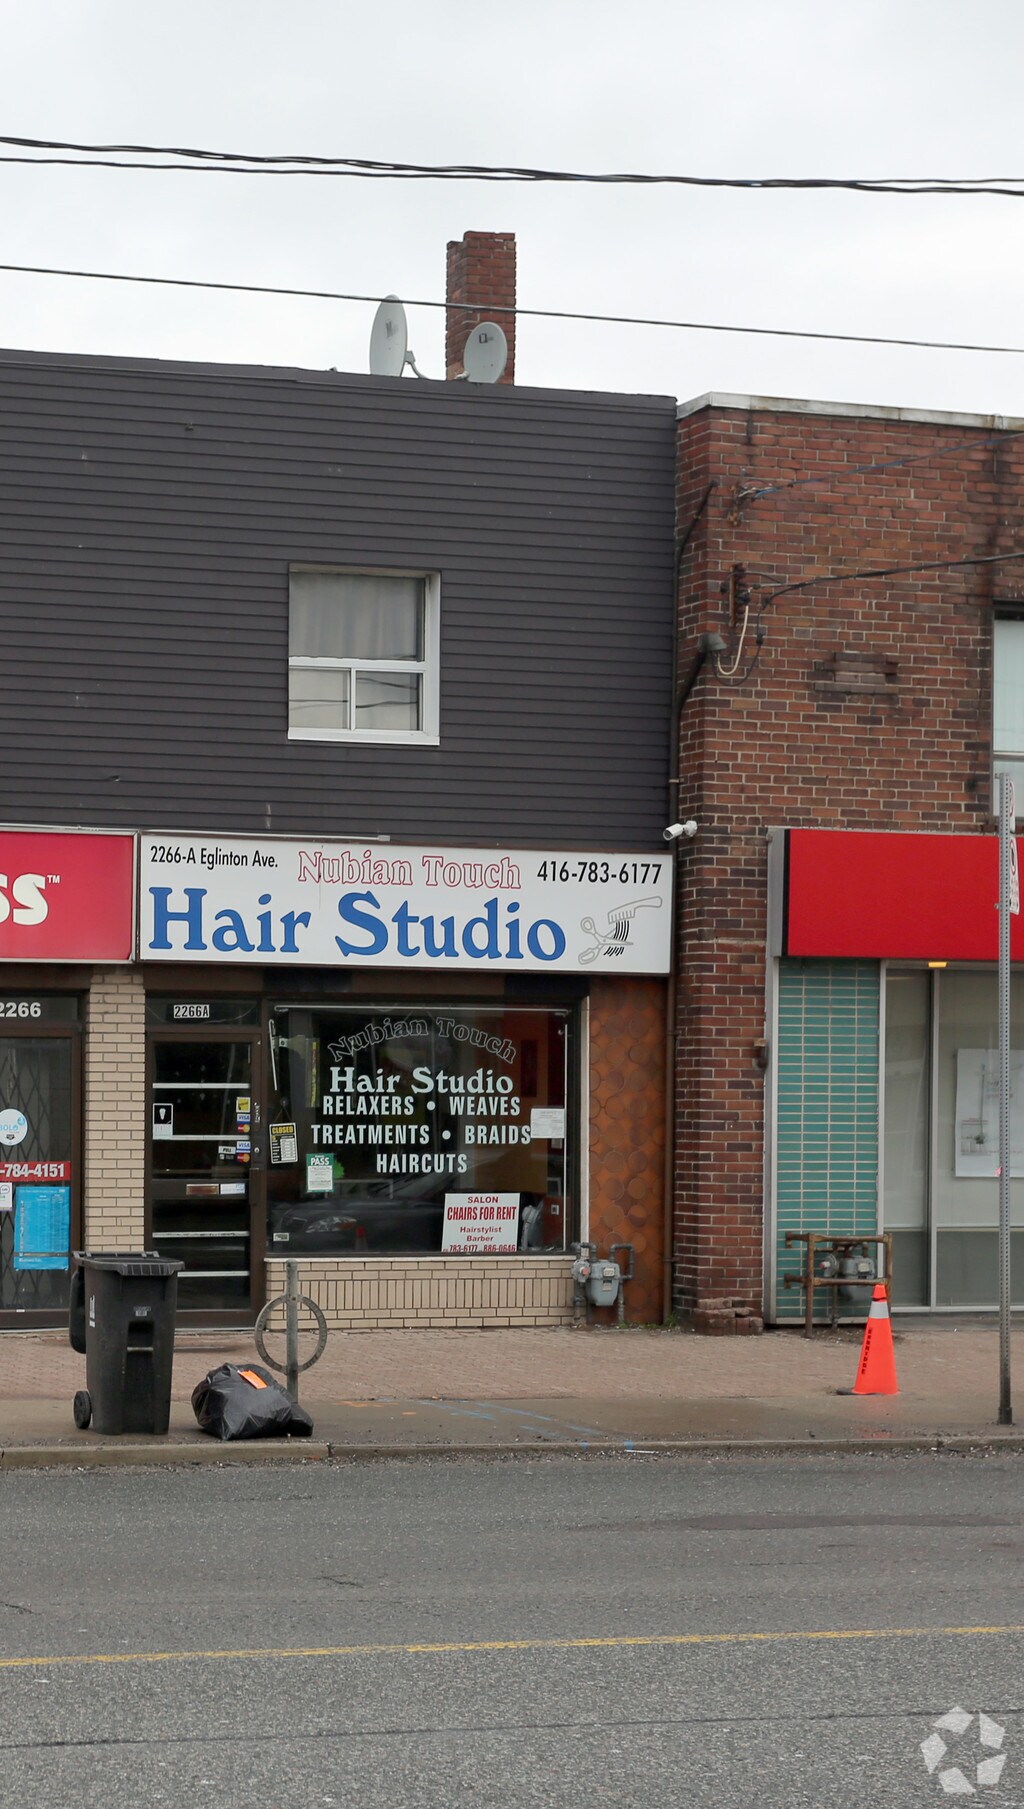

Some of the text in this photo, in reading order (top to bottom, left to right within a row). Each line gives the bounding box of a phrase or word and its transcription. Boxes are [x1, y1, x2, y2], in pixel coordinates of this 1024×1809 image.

[150, 846, 278, 870] 2266-A Eglinton Ave.
[298, 850, 521, 890] Nubian Touch
[537, 861, 662, 884] 416-783-6177
[148, 886, 567, 961] Hair Studio
[174, 1005, 209, 1018] 2266A
[328, 1016, 517, 1064] Nubian Touch
[329, 1066, 400, 1093] Hair
[411, 1066, 513, 1094] Studio
[323, 1095, 520, 1116] RELAXERS WEAVES
[272, 1126, 293, 1134] CLOSED
[311, 1124, 531, 1145] TREATMENTS BRAIDS
[310, 1157, 330, 1166] PASS
[376, 1154, 468, 1173] HAIRCUTS
[467, 1196, 499, 1204] SALON
[447, 1207, 517, 1220] CHAIRS FOR RENT
[460, 1226, 502, 1234] Hairstylist
